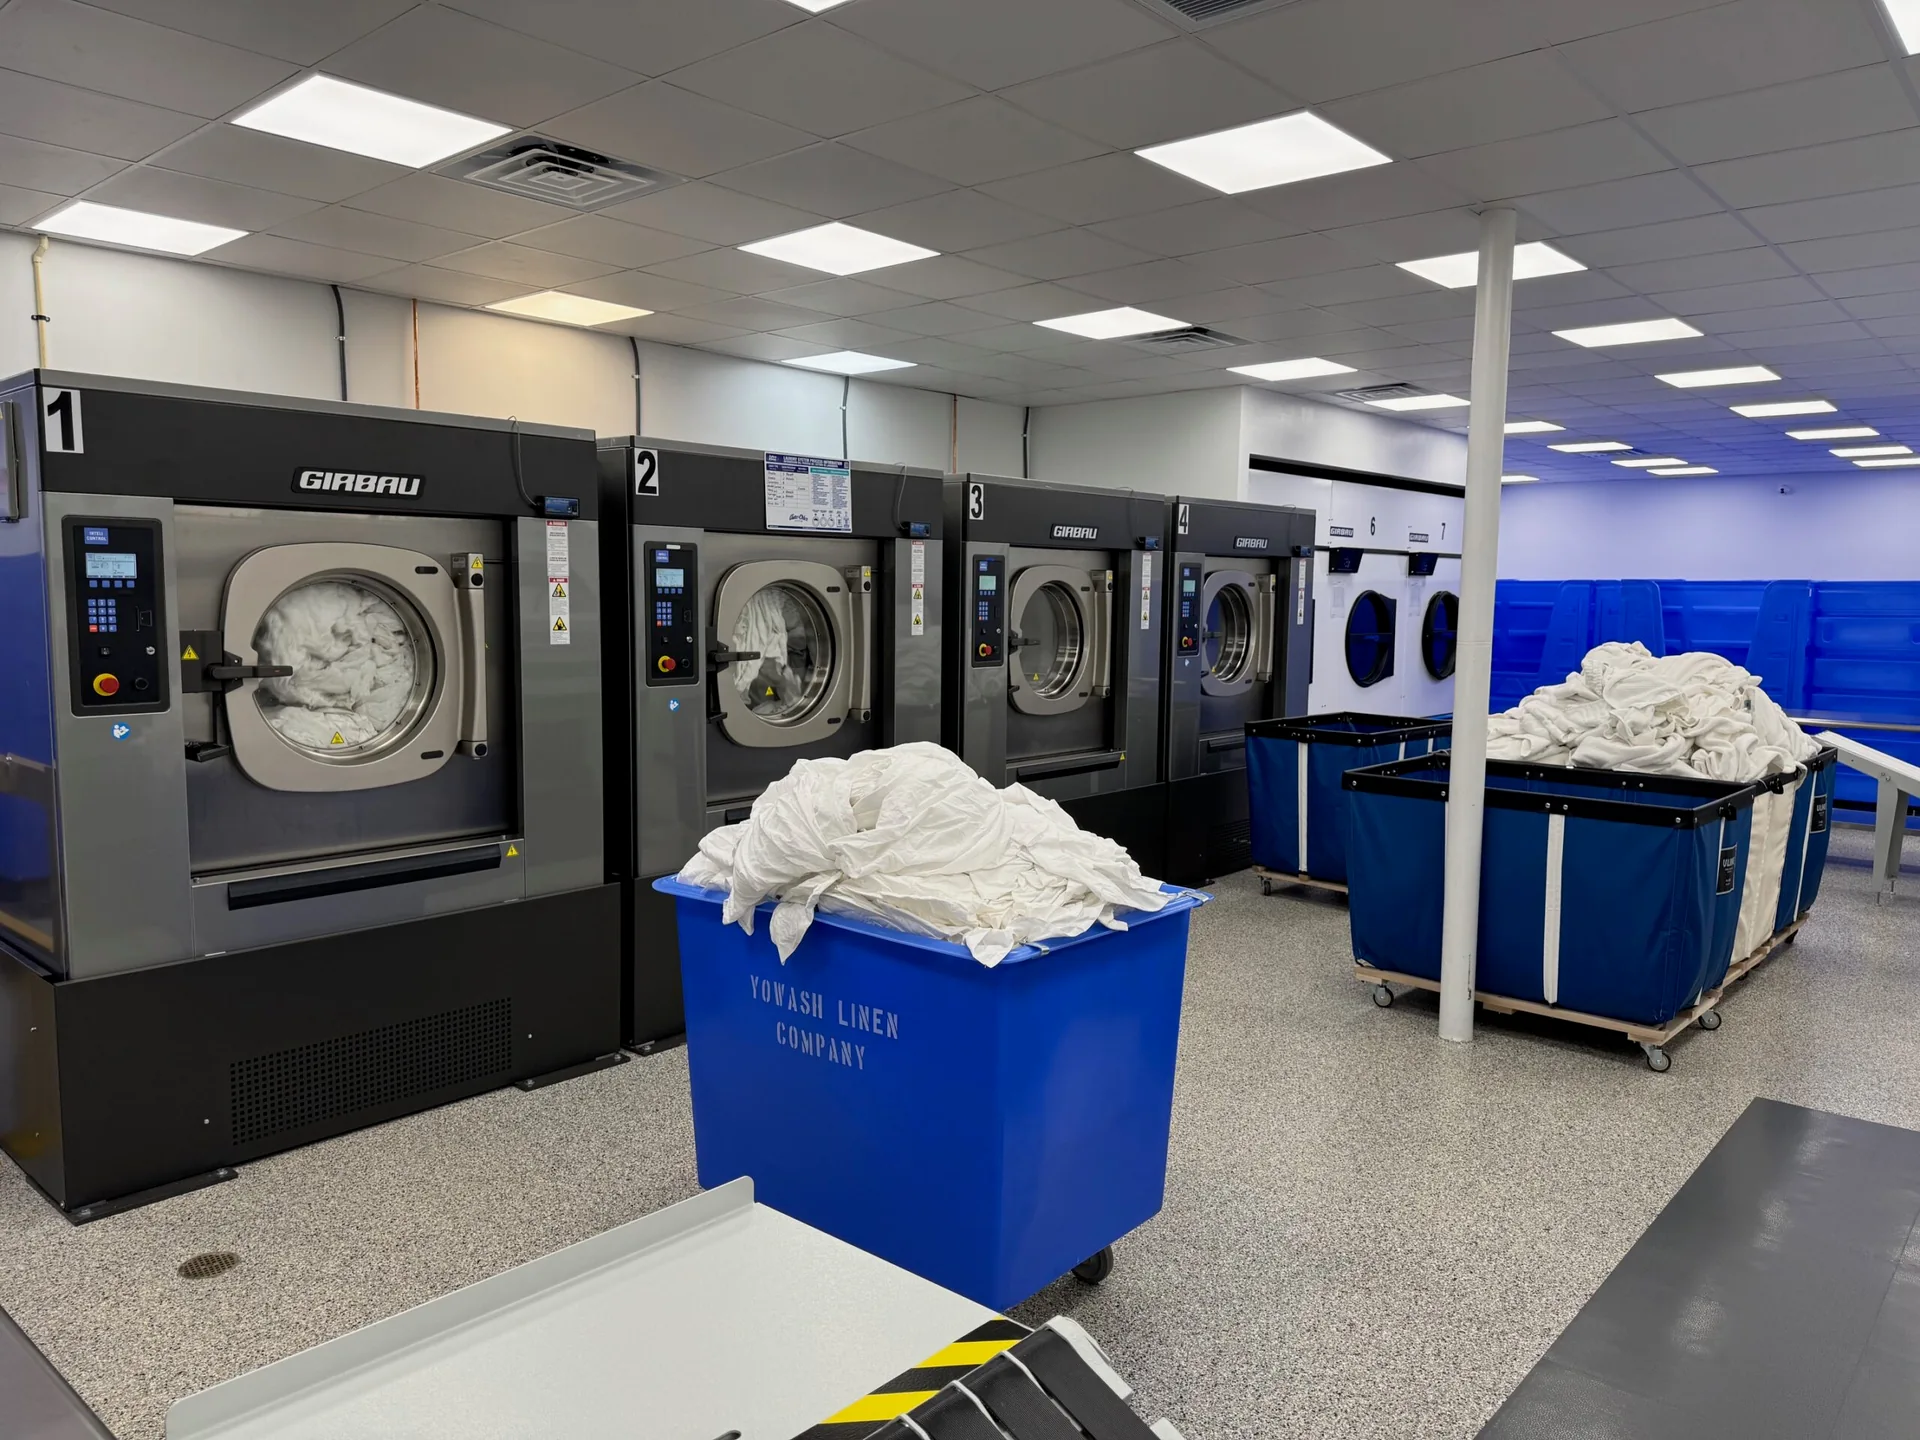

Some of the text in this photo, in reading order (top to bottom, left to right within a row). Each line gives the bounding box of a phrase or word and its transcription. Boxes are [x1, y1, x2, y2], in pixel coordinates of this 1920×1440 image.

[47, 390, 75, 451] 1
[299, 470, 421, 496] GIRBAU
[637, 450, 657, 495] 2
[971, 484, 983, 519] 3
[1053, 525, 1098, 540] GIRBAU
[1179, 505, 1188, 533] 4
[1330, 527, 1353, 537] GIRBAU
[1370, 516, 1376, 536] 6
[1441, 522, 1446, 540] 7
[1236, 537, 1268, 549] GIRBAU
[750, 974, 898, 1039] YOWASH LINEN
[776, 1021, 865, 1070] COMPANY
